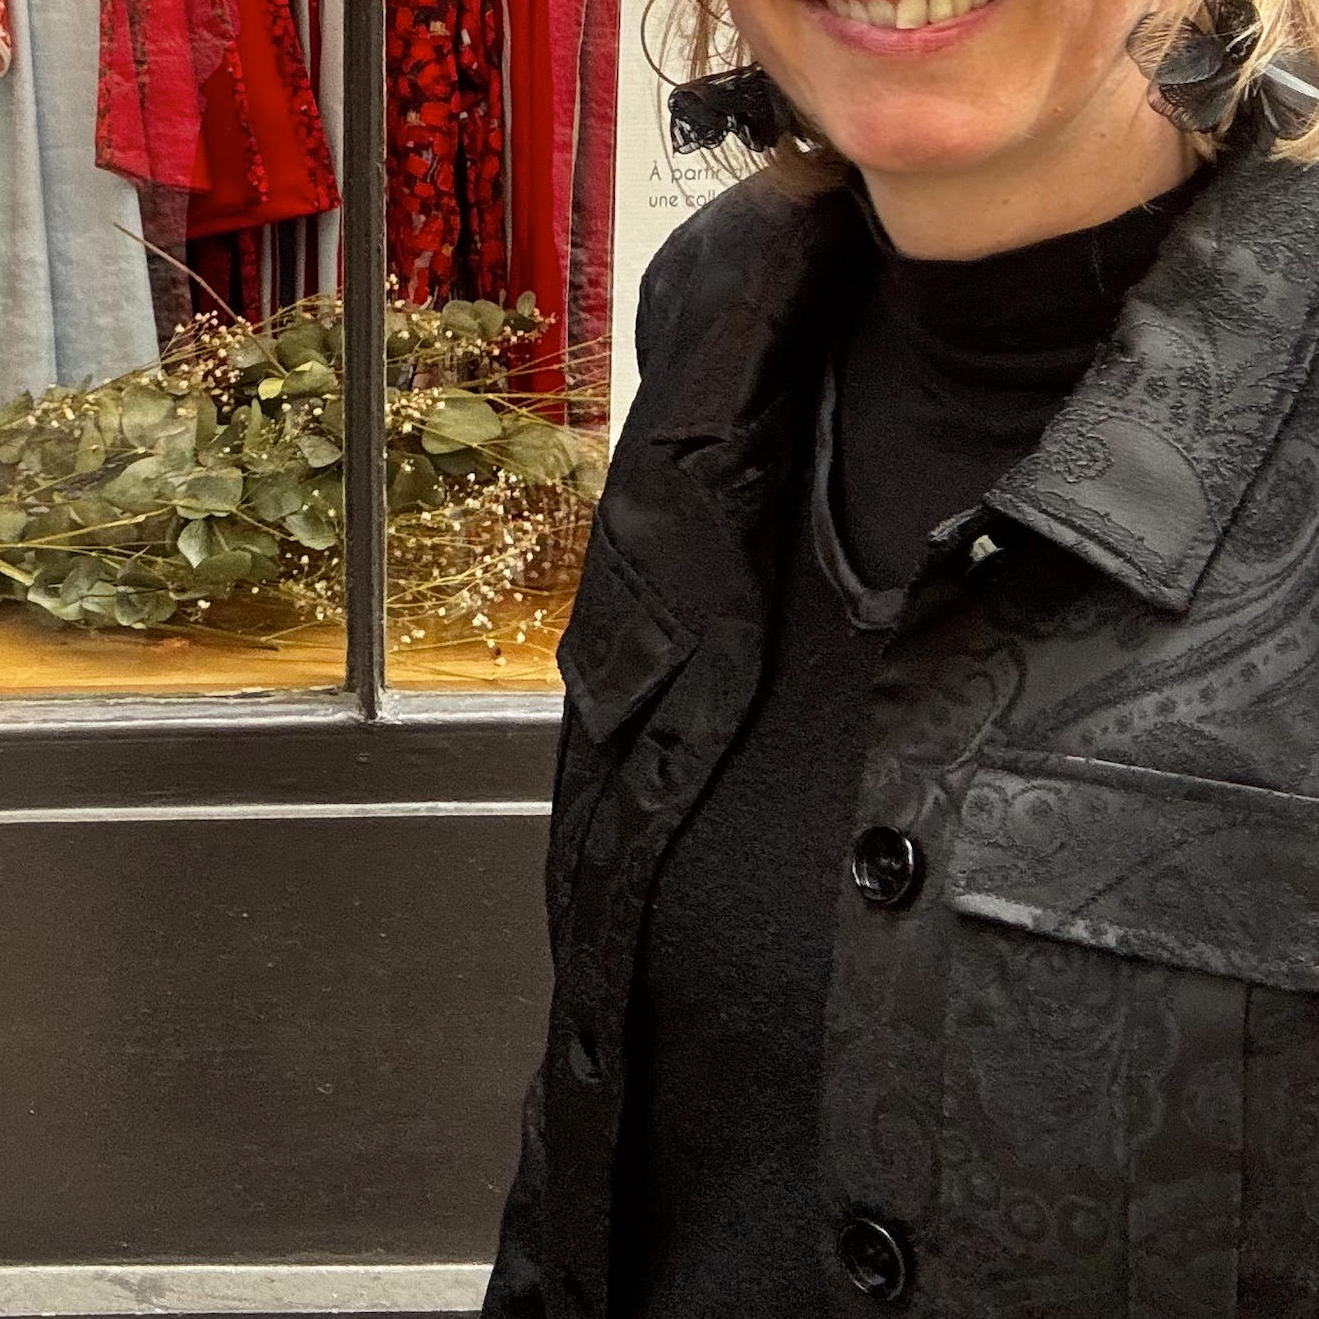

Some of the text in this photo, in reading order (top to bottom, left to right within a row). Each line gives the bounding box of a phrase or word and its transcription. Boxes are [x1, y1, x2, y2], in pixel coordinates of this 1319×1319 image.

[649, 160, 662, 181] À
[671, 165, 722, 184] partir
[649, 195, 679, 208] une
